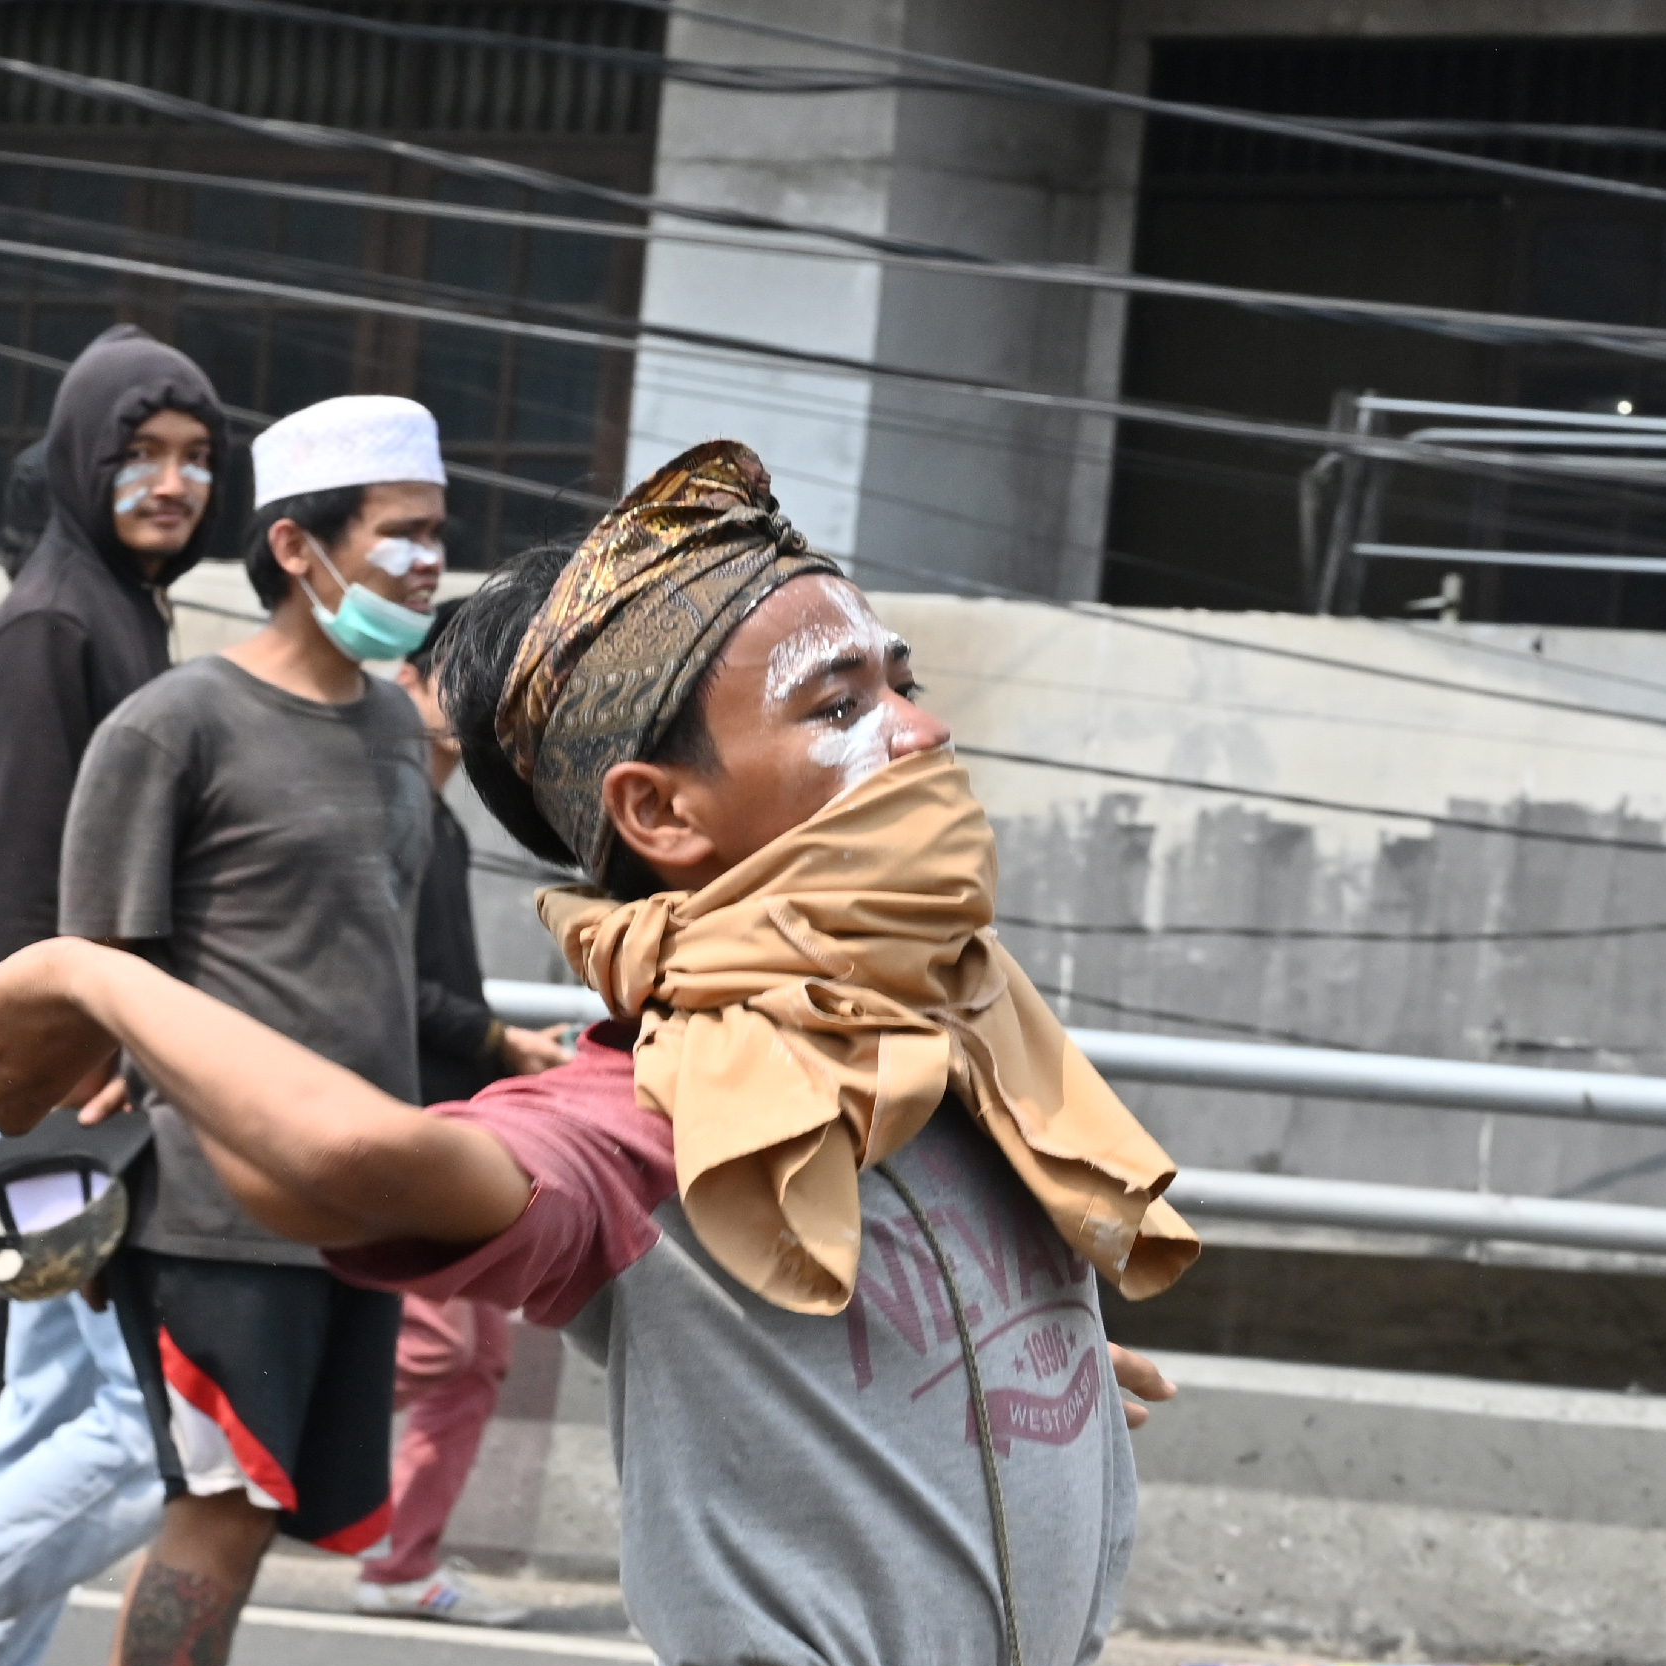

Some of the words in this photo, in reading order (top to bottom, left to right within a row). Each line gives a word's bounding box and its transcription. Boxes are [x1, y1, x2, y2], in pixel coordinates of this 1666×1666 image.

[1023, 1321, 1069, 1381] 1996
[1008, 1402, 1061, 1434] WEST
[1062, 1366, 1092, 1430] COAST
